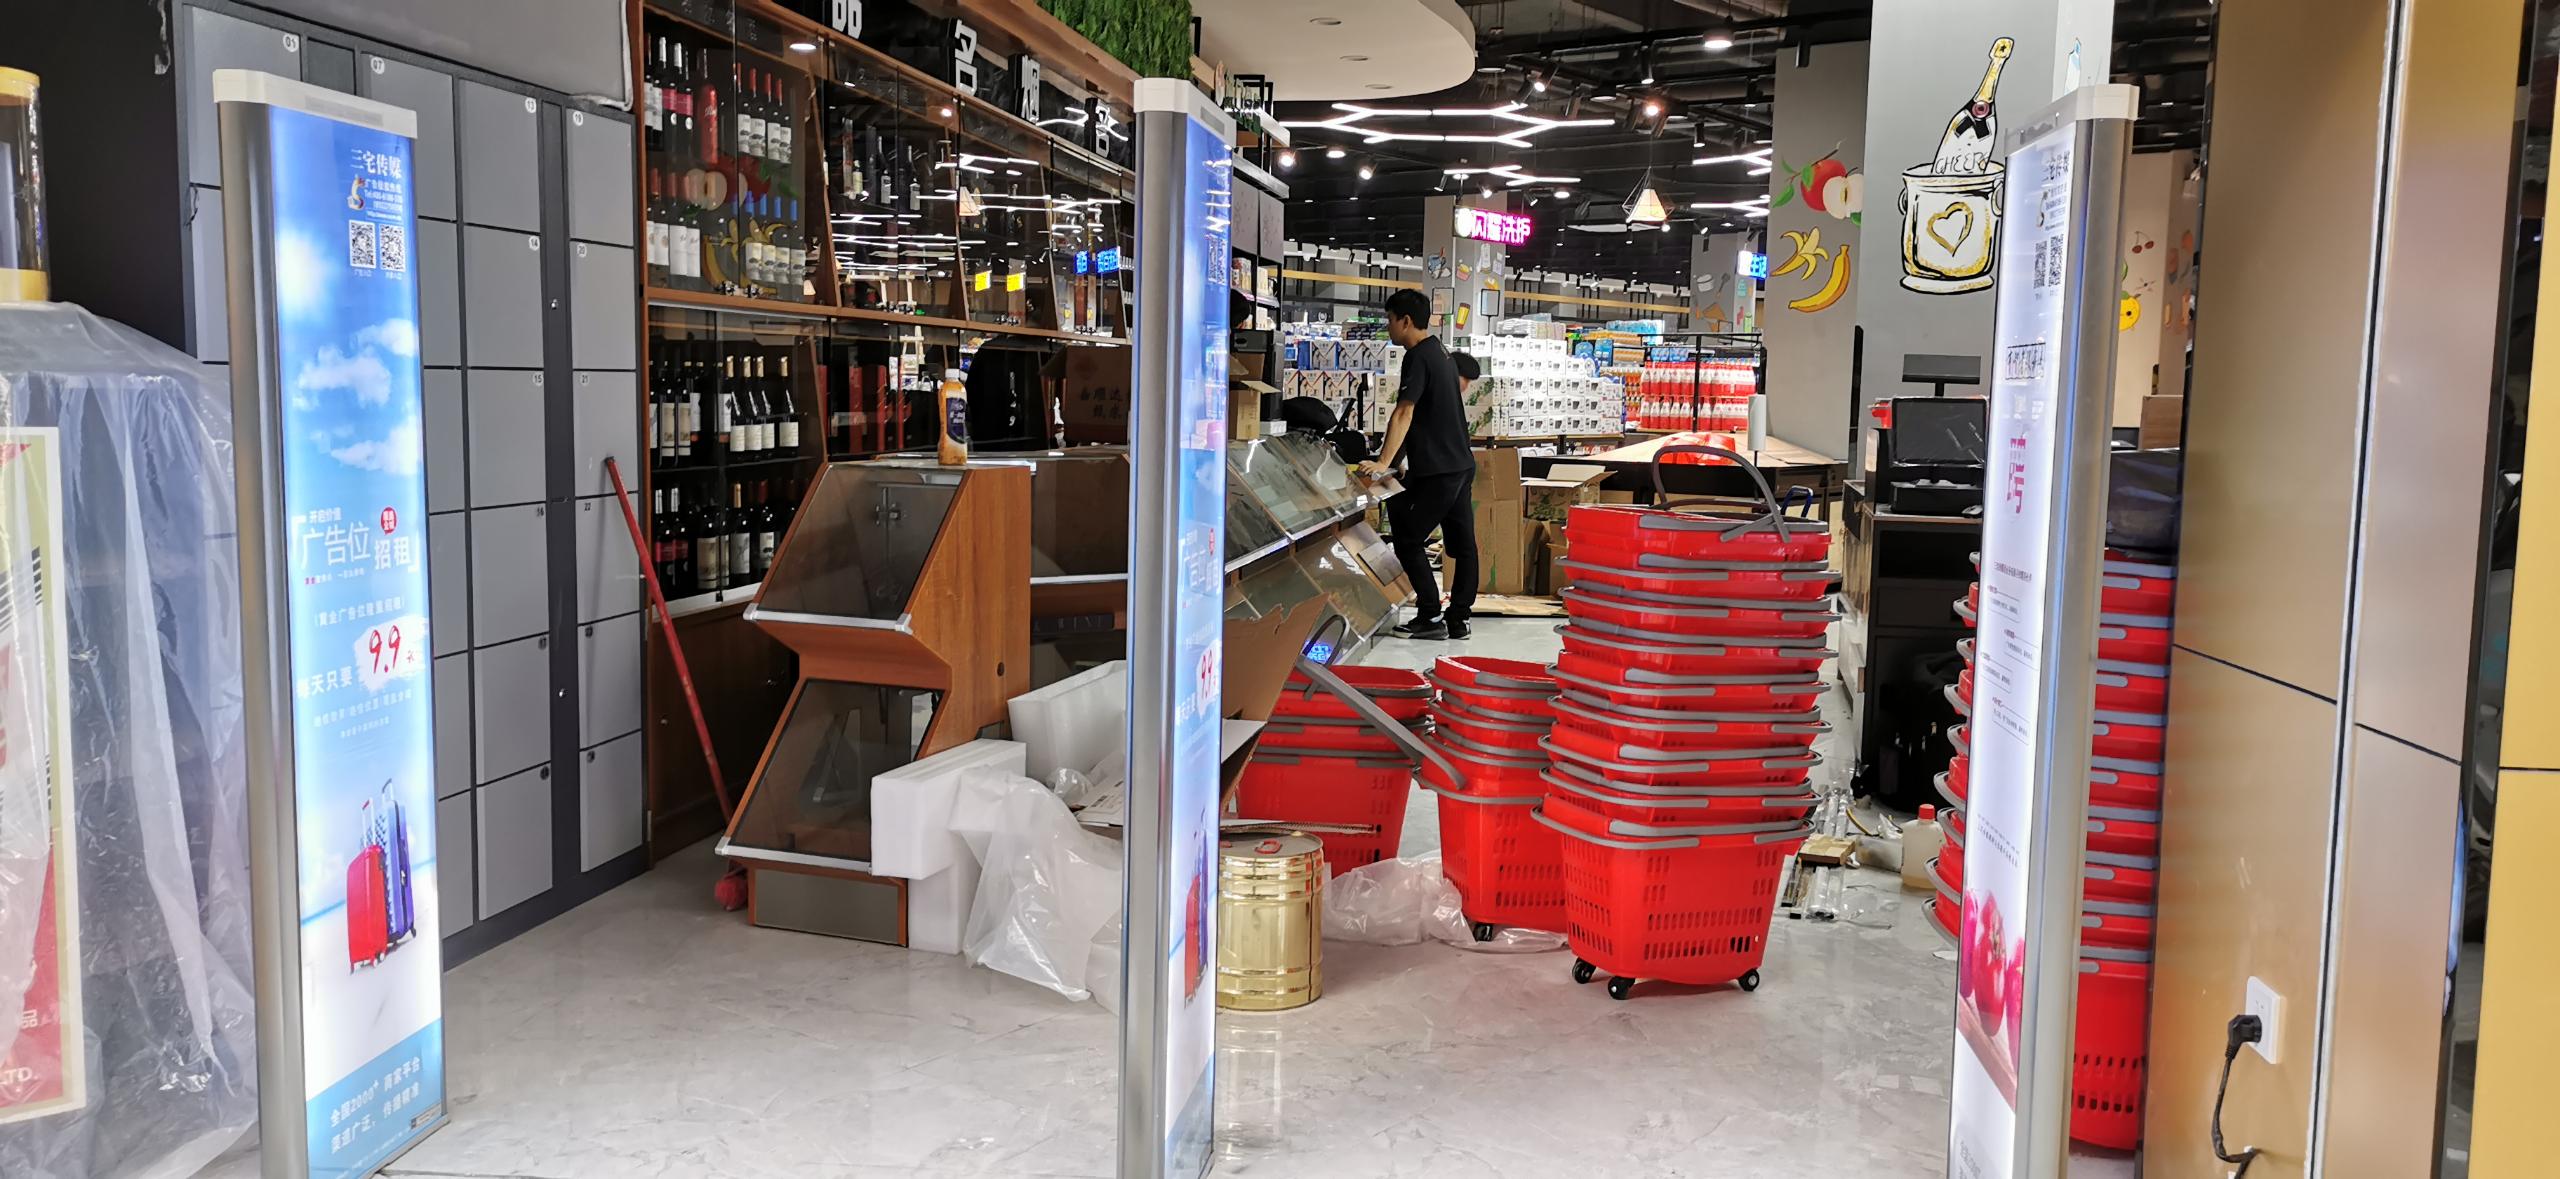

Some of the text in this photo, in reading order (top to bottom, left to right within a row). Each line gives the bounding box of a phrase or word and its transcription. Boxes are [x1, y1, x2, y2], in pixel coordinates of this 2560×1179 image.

[350, 148, 403, 179] 三宅传媒
[300, 522, 412, 570] 广告位 招租
[369, 625, 401, 674] 9.9
